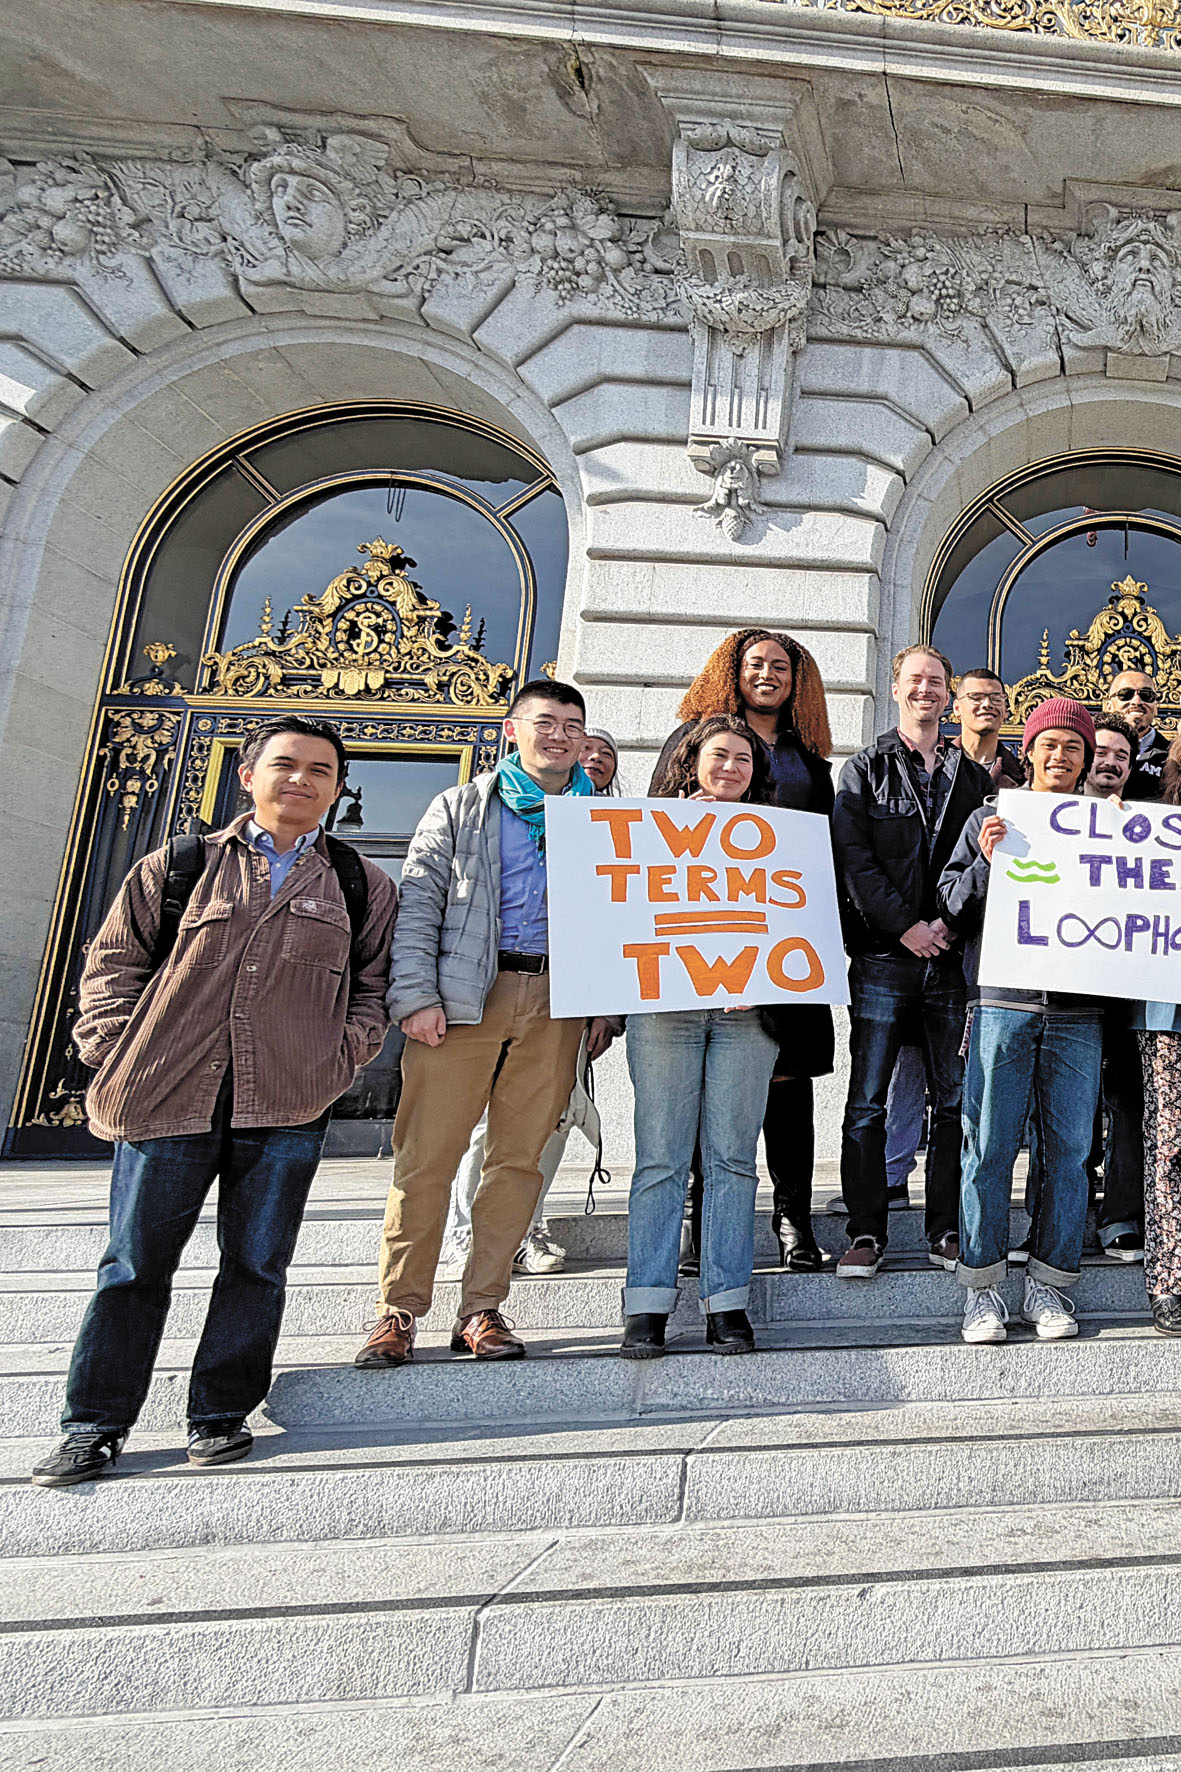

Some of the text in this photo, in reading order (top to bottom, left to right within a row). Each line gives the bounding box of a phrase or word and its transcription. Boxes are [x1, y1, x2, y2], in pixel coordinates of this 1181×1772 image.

[589, 808, 777, 860] TWO
[595, 864, 807, 909] TERMS
[1079, 854, 1176, 891] THE
[622, 936, 825, 1000] TWO
